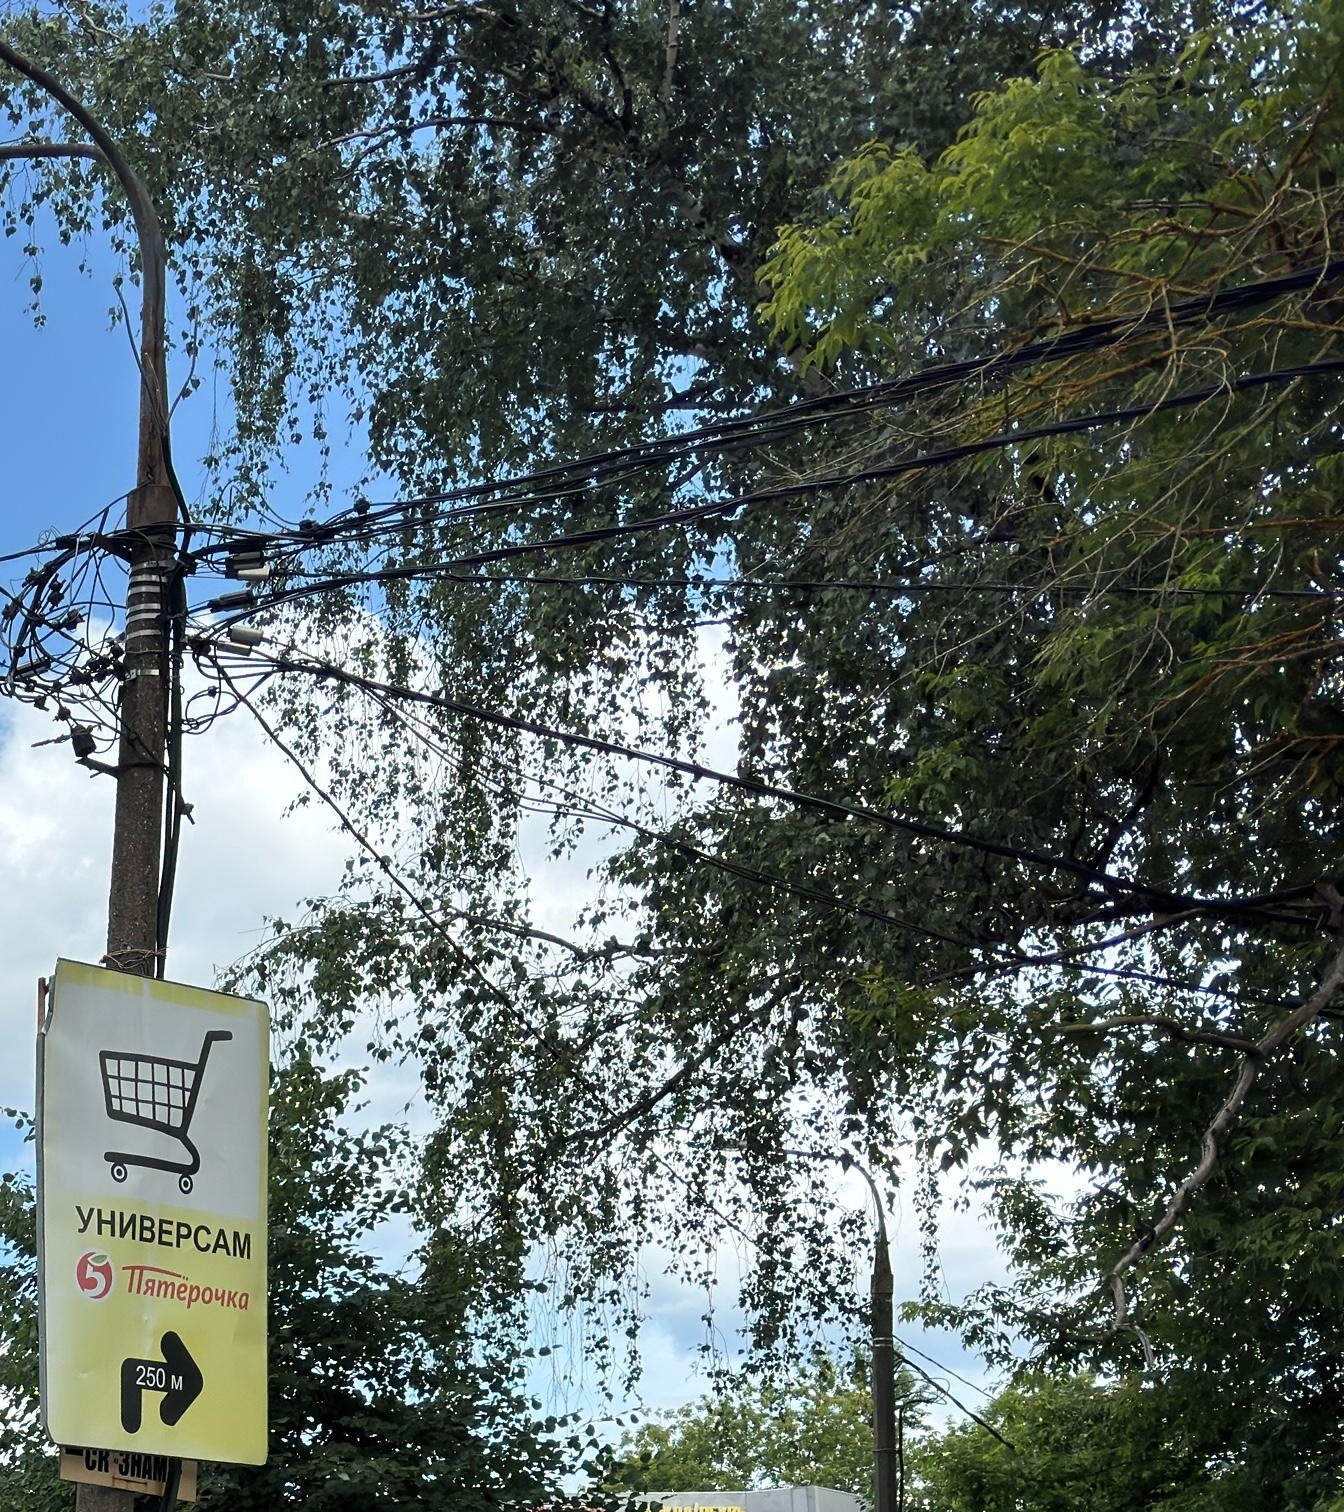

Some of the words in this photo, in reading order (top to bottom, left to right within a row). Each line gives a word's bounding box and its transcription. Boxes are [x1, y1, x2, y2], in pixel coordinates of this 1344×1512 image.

[75, 1205, 251, 1260] УНИВЕРСАМ
[122, 1265, 250, 1310] Пятёрочка
[135, 1365, 166, 1389] 250
